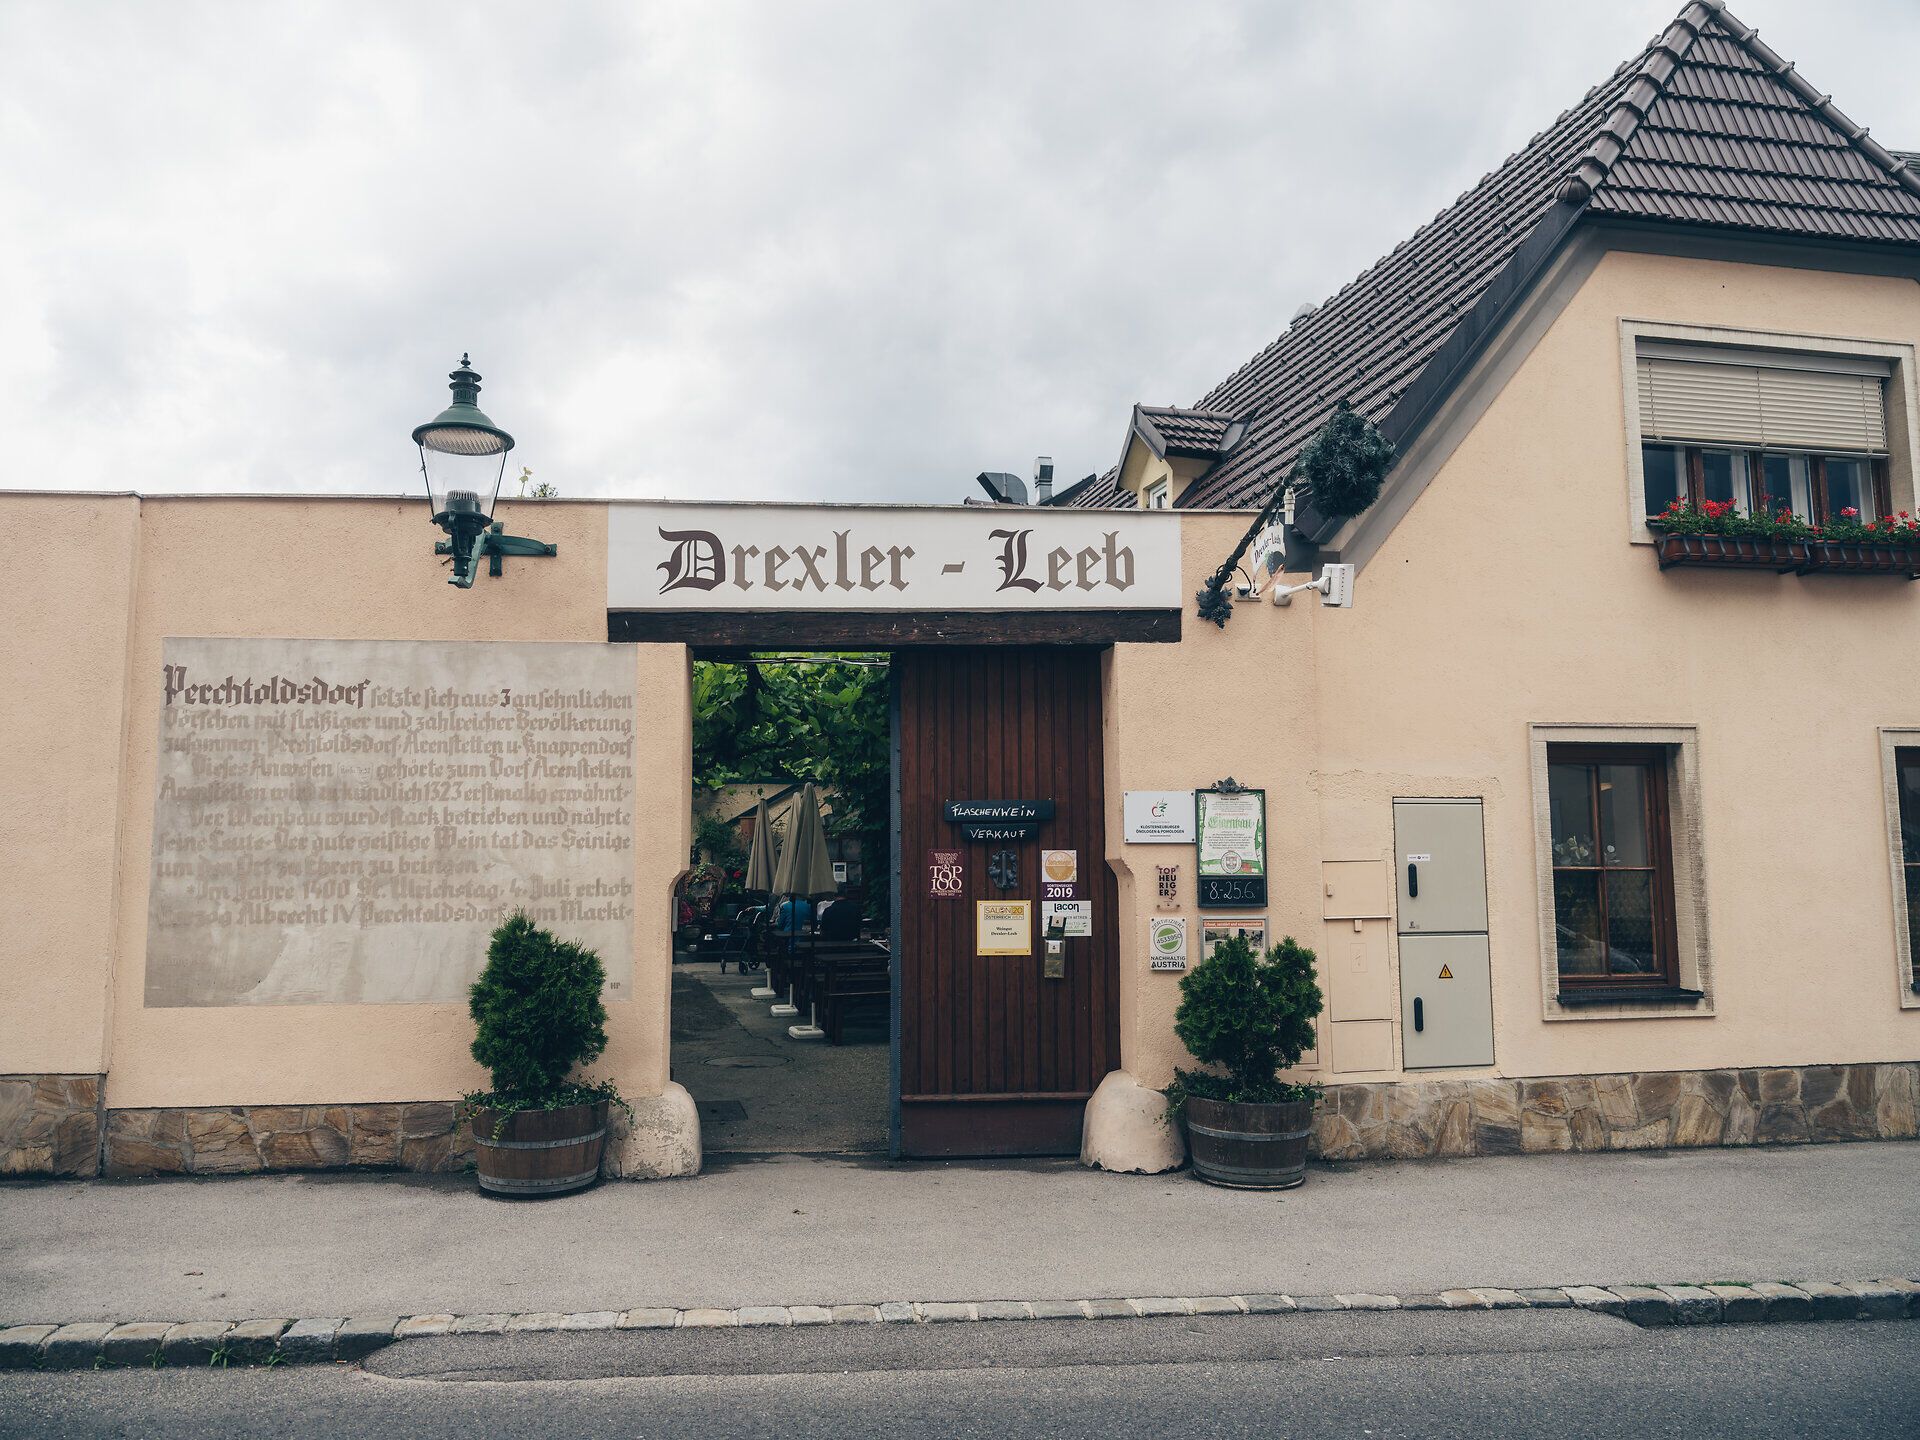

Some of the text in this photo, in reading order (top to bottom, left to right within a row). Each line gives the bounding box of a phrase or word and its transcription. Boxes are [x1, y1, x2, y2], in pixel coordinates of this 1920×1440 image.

[656, 525, 1135, 595] Drexler - Leeb
[163, 663, 371, 709] Perchtoldsdorf
[461, 691, 498, 708] aus
[499, 688, 511, 708] 3
[253, 709, 287, 730] mit
[374, 709, 412, 731] und
[515, 708, 632, 735] Bevölkerung
[522, 730, 635, 759] Knappendorf
[376, 757, 443, 781] gehörte
[446, 764, 486, 780] zum
[489, 752, 531, 780] Dorf
[423, 780, 463, 802] 1323
[325, 803, 389, 827] wurde
[443, 805, 529, 826] betrieben
[532, 805, 568, 826] und
[570, 806, 631, 829] nährte
[312, 831, 354, 856] gute
[434, 825, 487, 851] Wein
[491, 829, 520, 850] tat
[522, 829, 558, 850] das
[970, 828, 1027, 839] VERKAUF
[157, 861, 194, 878] um
[368, 859, 394, 879] zu
[930, 866, 963, 883] TOP
[302, 878, 350, 900] 1400
[576, 876, 633, 898] erhob
[931, 877, 963, 890] 100
[1046, 887, 1073, 898] 2019
[332, 903, 357, 924] IV
